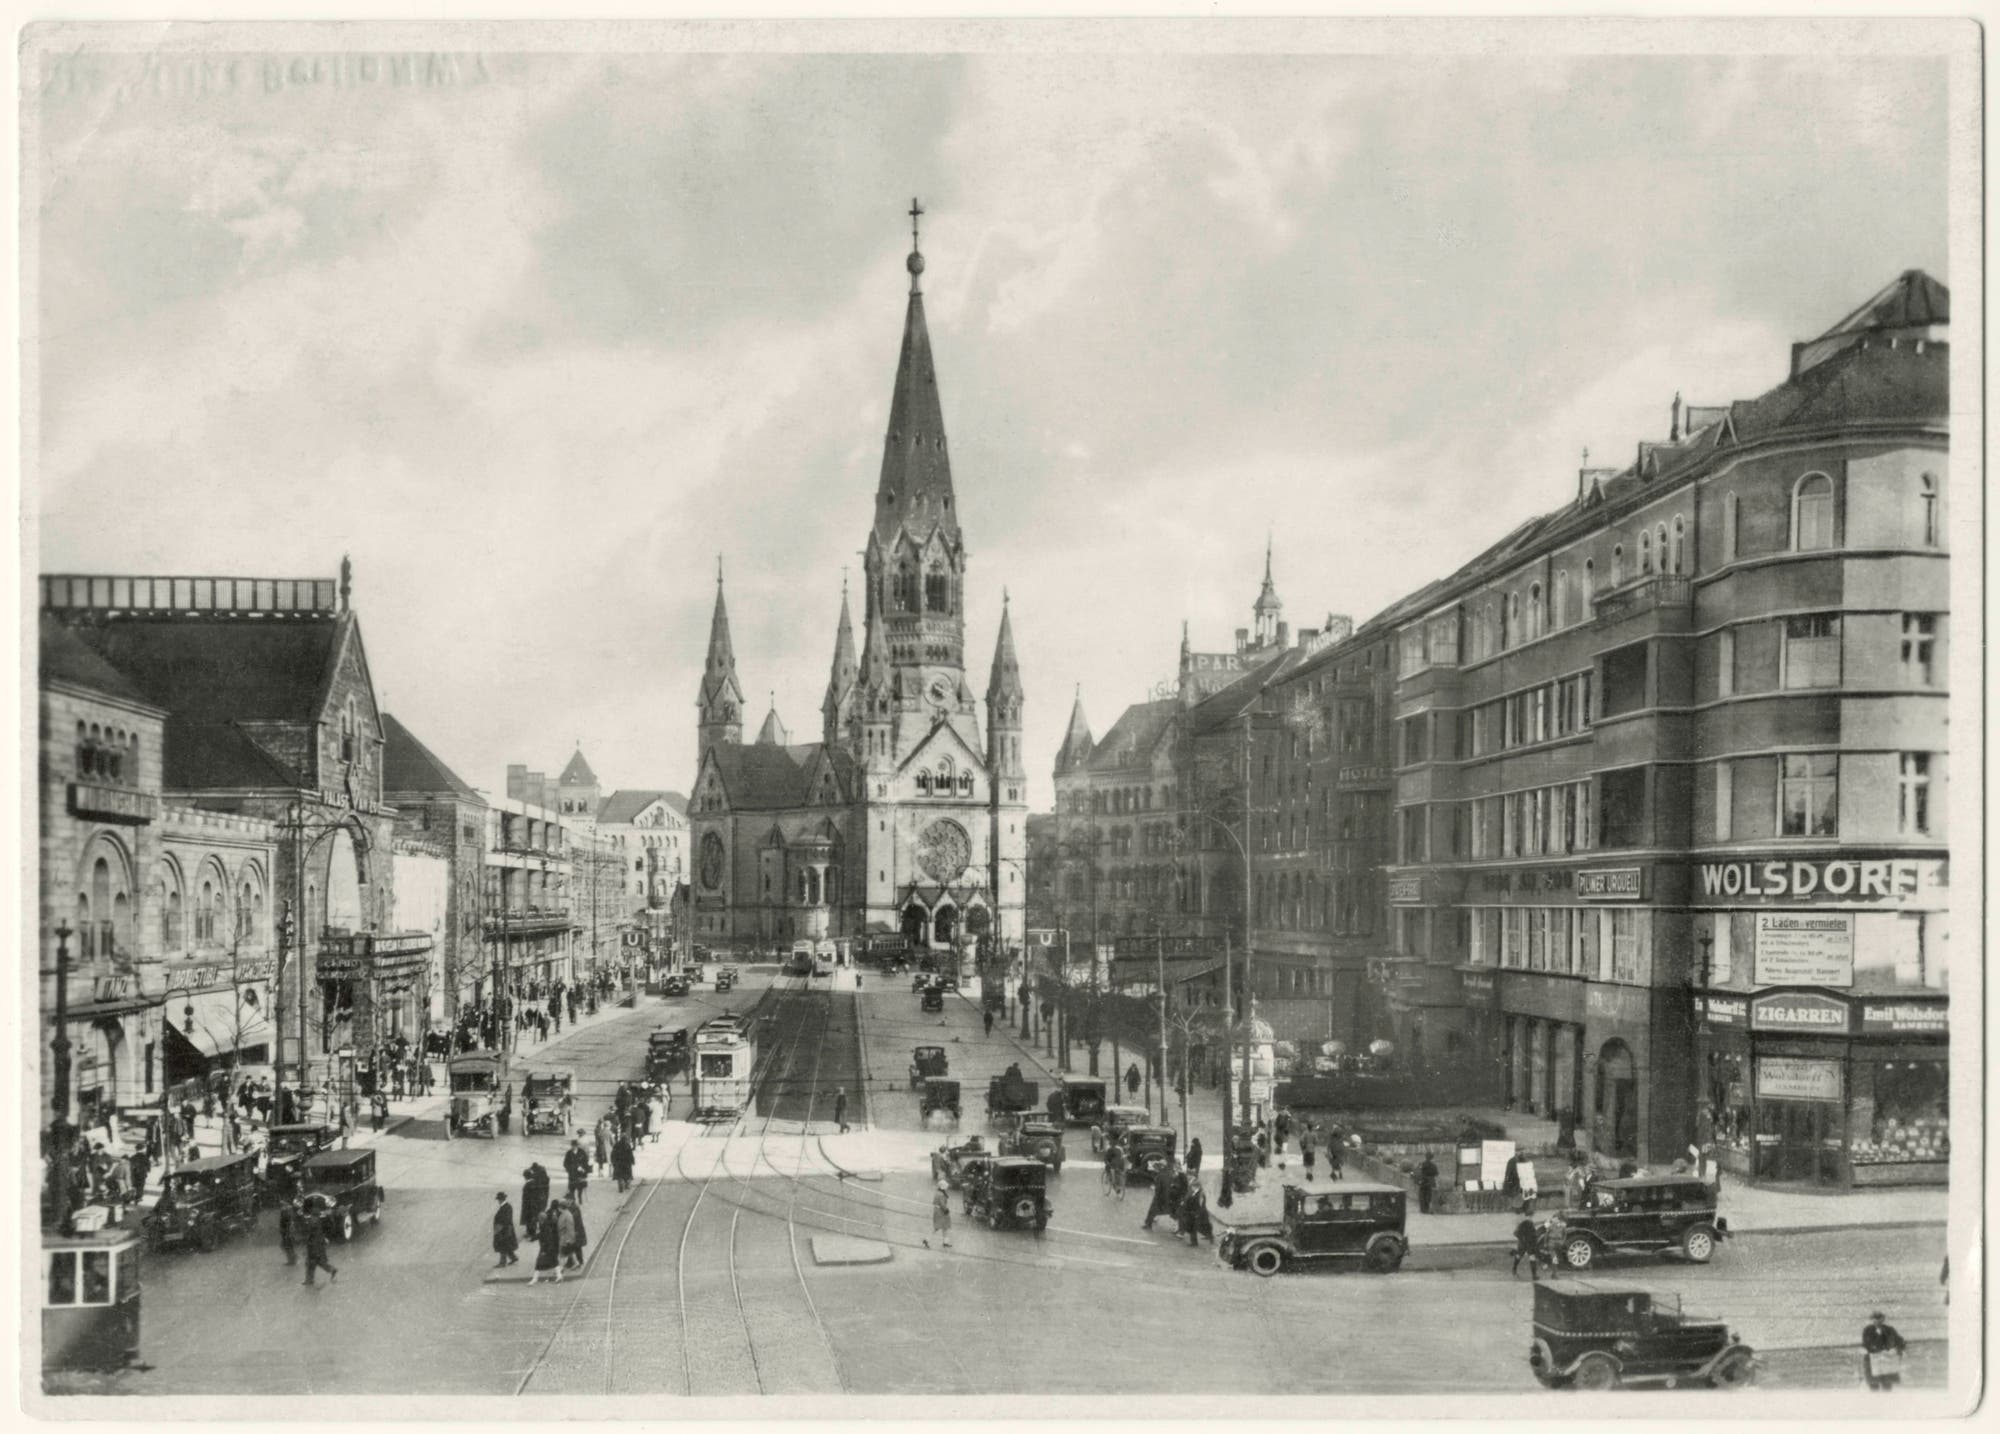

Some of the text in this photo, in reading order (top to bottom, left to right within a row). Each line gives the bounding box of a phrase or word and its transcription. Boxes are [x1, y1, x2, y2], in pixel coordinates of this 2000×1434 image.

[1762, 918, 1769, 928] 2
[627, 933, 639, 946] U
[1040, 933, 1052, 946] U
[1758, 1007, 1842, 1023] ZIGARREN
[1863, 1006, 1949, 1021] Emil Wolsdor
